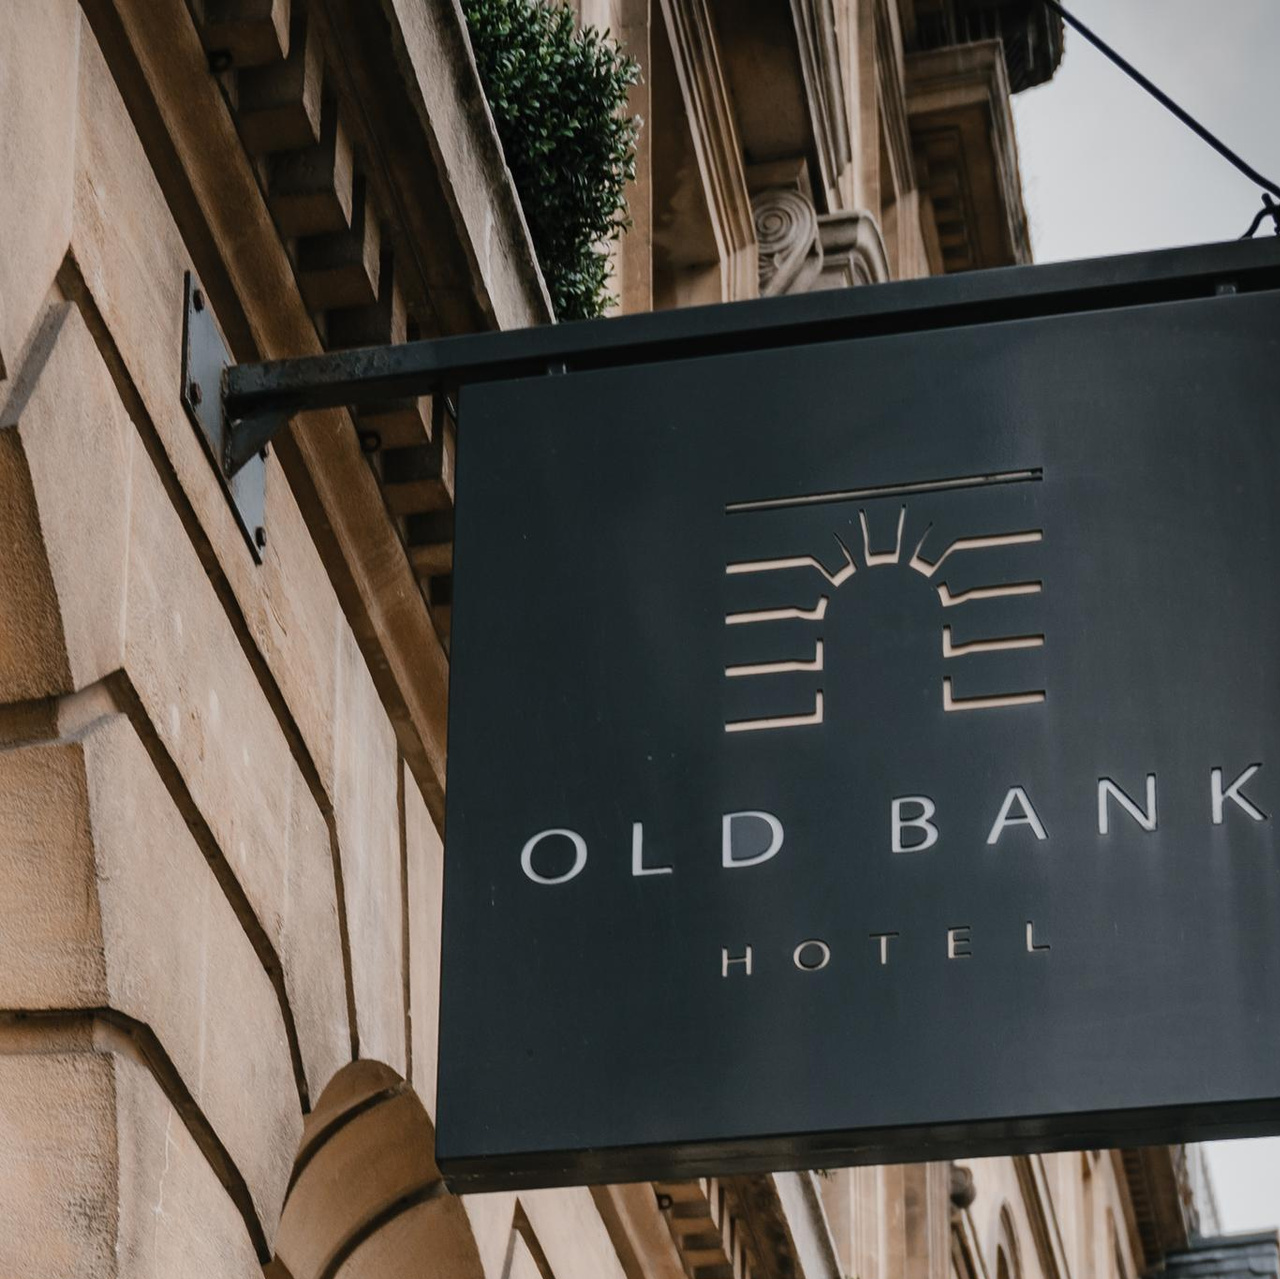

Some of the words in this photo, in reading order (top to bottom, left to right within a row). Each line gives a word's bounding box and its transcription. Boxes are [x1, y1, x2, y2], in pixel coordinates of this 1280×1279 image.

[520, 810, 785, 884] OLD
[889, 762, 1269, 855] BANK
[721, 921, 1051, 978] HOTEL
